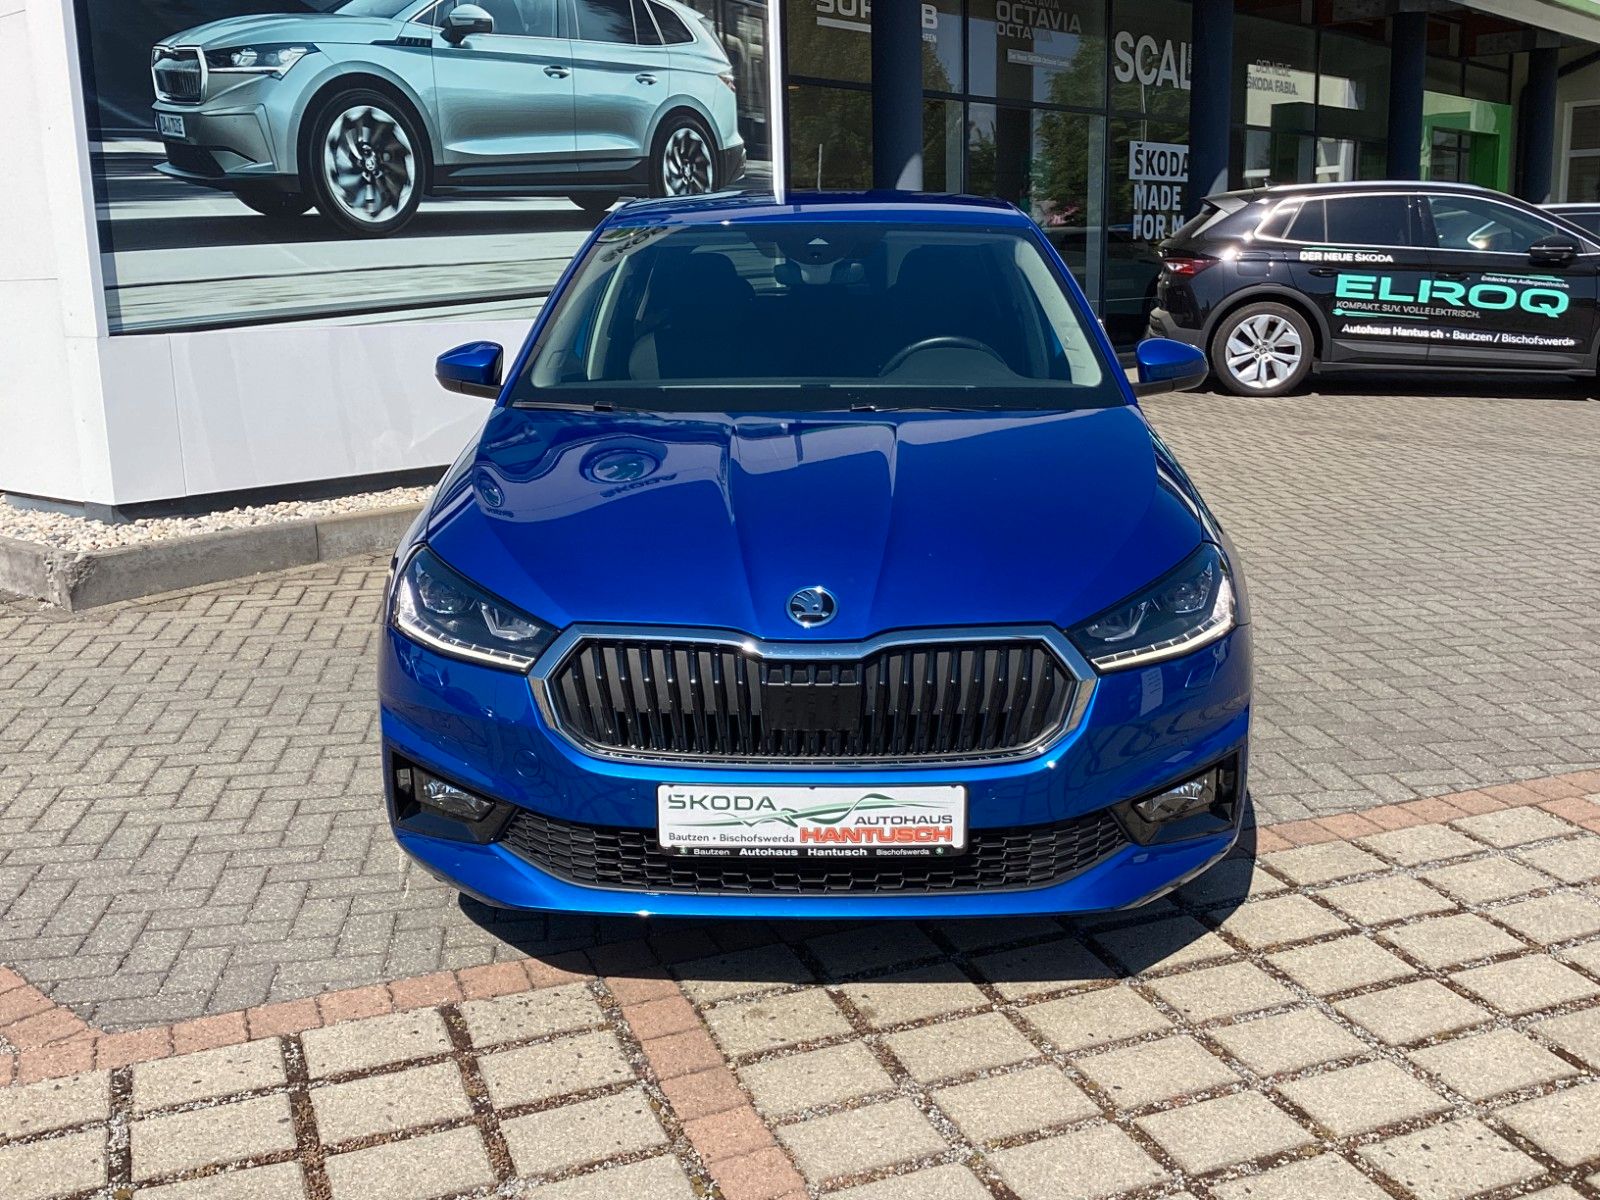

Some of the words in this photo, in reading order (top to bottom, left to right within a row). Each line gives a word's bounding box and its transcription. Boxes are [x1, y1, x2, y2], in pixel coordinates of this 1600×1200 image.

[996, 1, 1082, 33] OCTAVIA
[1256, 59, 1271, 74] DER
[1133, 184, 1182, 211] MADE
[1132, 214, 1166, 240] FOR
[1300, 251, 1322, 261] DER
[1323, 252, 1353, 262] NEUE
[1335, 274, 1570, 319] ELROQ
[1335, 300, 1380, 311] KOMPAKT.
[1381, 304, 1401, 313] SUV.
[1341, 323, 1392, 336] Autohaus
[1452, 330, 1493, 342] Bautzen
[1501, 333, 1575, 346] Bischofswerda
[854, 815, 953, 825] AUTOHAUS
[668, 832, 709, 841] Bautzen
[719, 833, 795, 843] Bischofswerda
[799, 826, 953, 843] HANTUSCH
[693, 848, 730, 856] Bautzen
[739, 848, 798, 856] Autohaus
[807, 848, 868, 857] Hantusch
[876, 848, 930, 856] Bischofswerda
